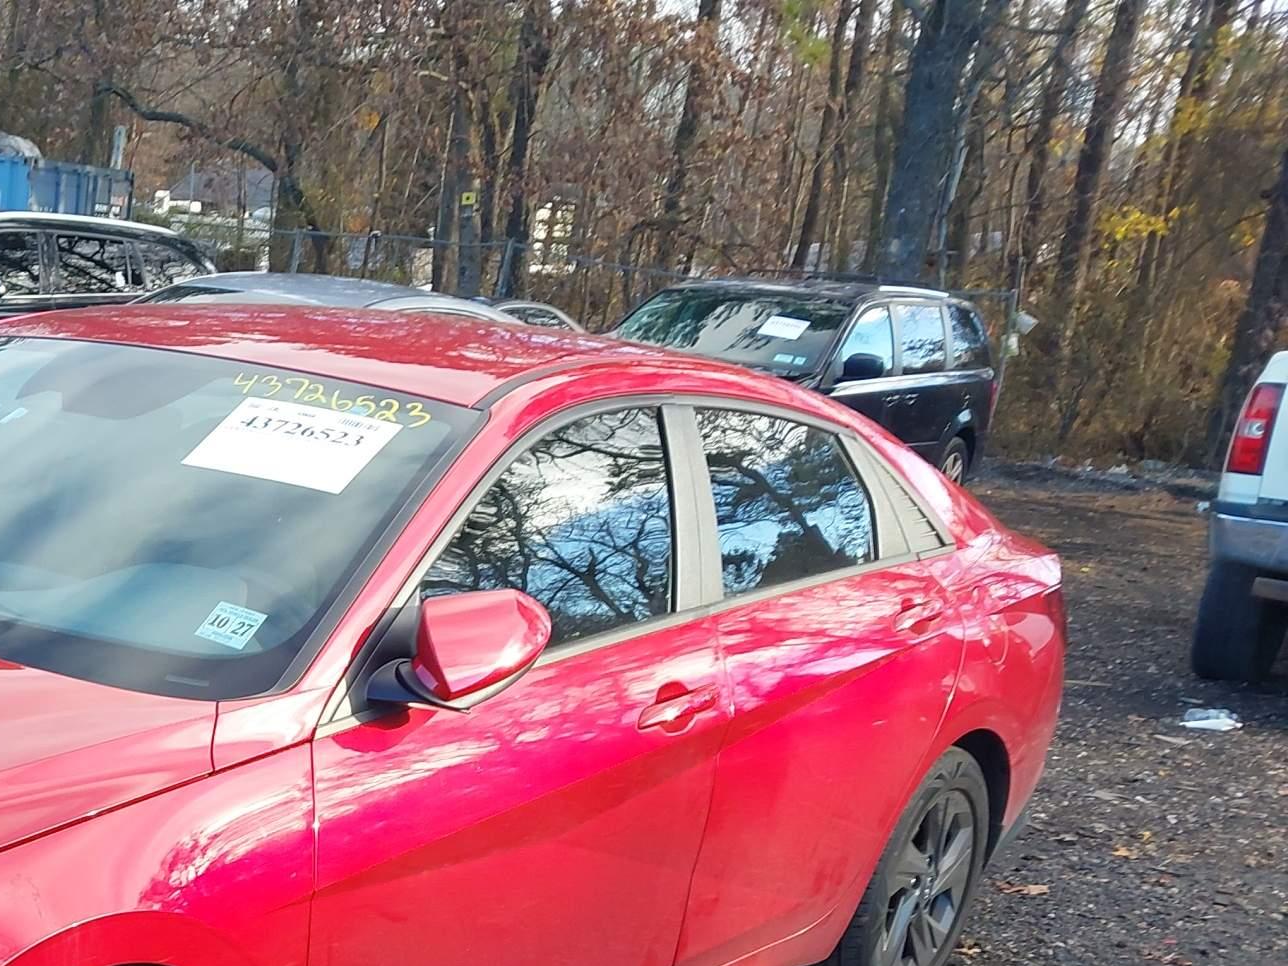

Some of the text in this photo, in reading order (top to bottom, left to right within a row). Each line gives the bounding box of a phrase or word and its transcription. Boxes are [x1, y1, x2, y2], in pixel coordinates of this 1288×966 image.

[232, 372, 432, 428] 43726523
[239, 415, 366, 447] 43726523
[207, 613, 231, 629] 10
[229, 620, 256, 637] 27
